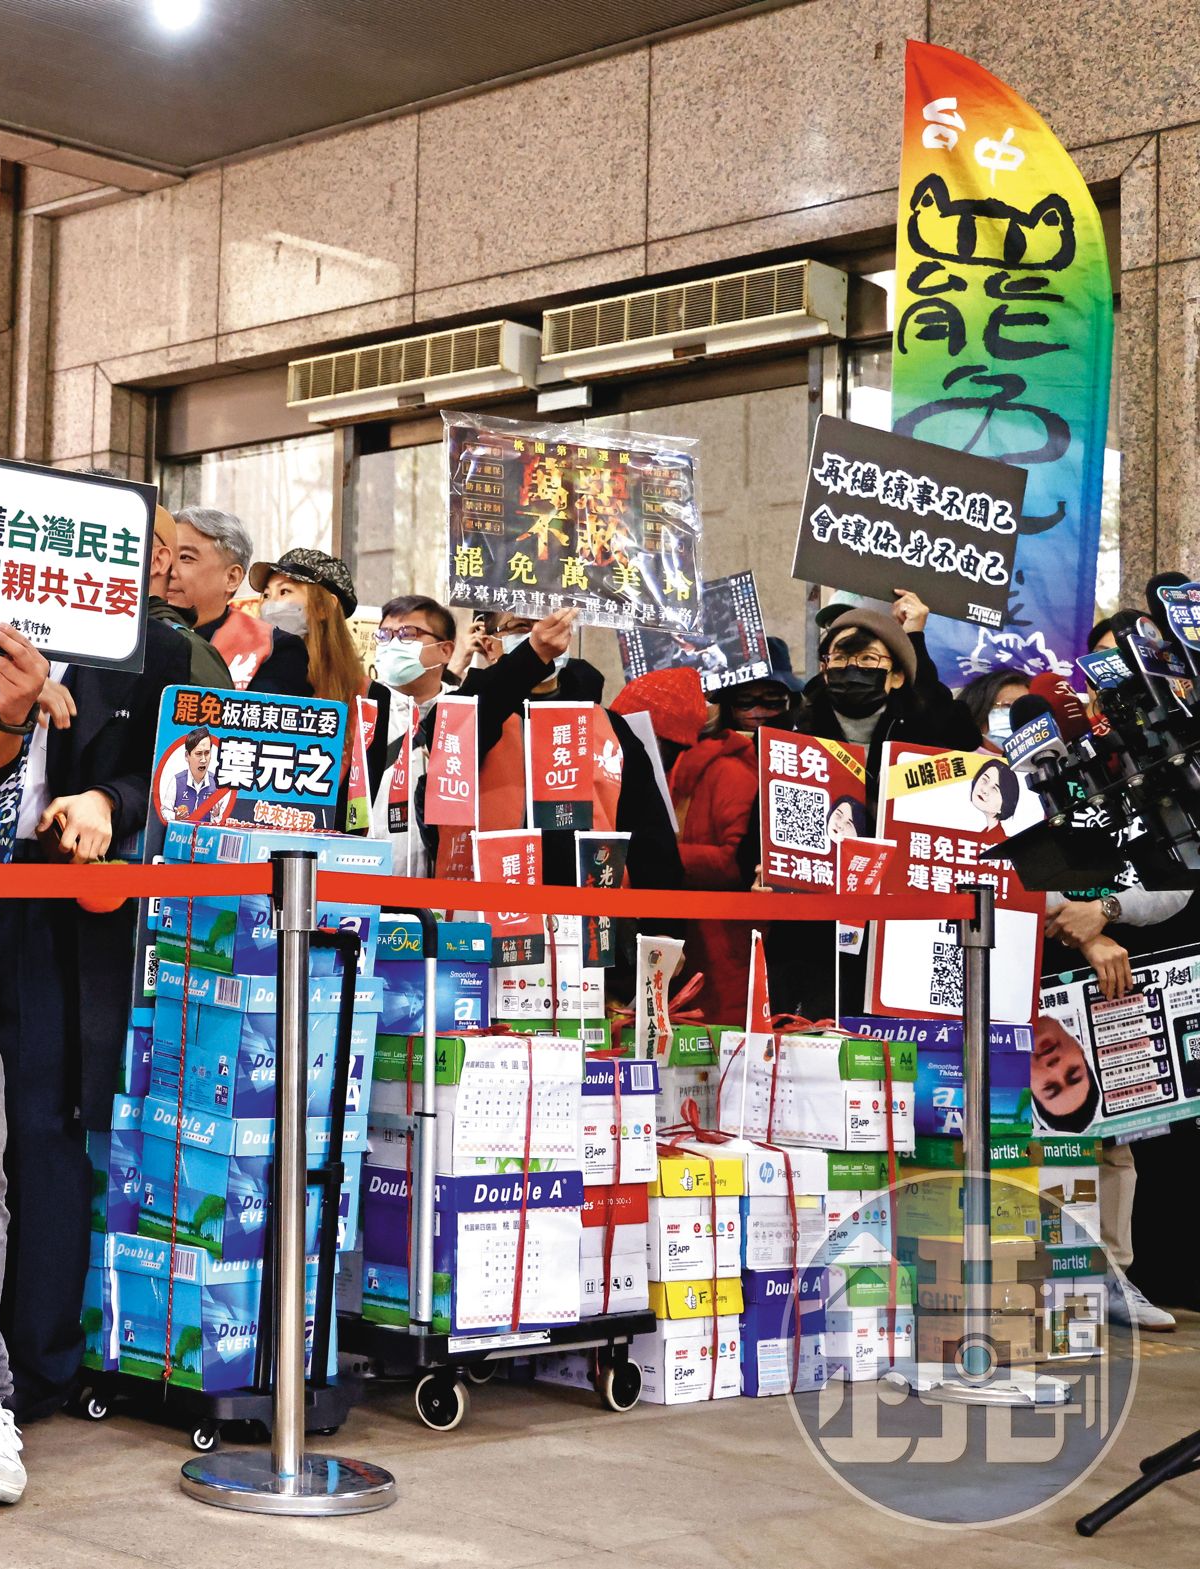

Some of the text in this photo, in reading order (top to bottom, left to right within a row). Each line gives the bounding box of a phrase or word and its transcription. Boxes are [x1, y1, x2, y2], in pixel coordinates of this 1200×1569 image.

[513, 439, 630, 466] 桃園第四選區
[812, 452, 1017, 535] 再繼續事不關己
[809, 504, 1009, 587] 會讓你身不由己
[731, 575, 751, 586] 5/17
[174, 691, 337, 736] 罷免板橋東區立委
[1004, 717, 1048, 752] mnews
[1034, 729, 1050, 744] 86
[552, 724, 572, 767] 罷免
[217, 739, 335, 794] 葉元之
[769, 739, 830, 783] 罷免
[545, 768, 579, 786] OUT
[905, 756, 967, 789] 山除薇害
[254, 800, 315, 829] 快來找我
[336, 856, 378, 865] EVERYDAY
[769, 851, 834, 887] 王鴻薇
[450, 970, 477, 979] Smoother
[460, 978, 483, 986] Thicker
[936, 1026, 949, 1042] A
[679, 1037, 696, 1052] BLC
[900, 1052, 912, 1065] A4
[928, 1062, 959, 1070] Smoother
[585, 1070, 613, 1084] ouble
[205, 1123, 216, 1135] A
[859, 1119, 869, 1127] APP
[594, 1147, 606, 1156] APP
[1043, 1143, 1081, 1158] martist
[777, 1168, 801, 1179] Paers
[474, 1180, 562, 1204] Double A
[837, 1231, 848, 1239] APP
[115, 1243, 166, 1262] Double A
[677, 1245, 690, 1254] APP
[1052, 1254, 1088, 1271] martist
[812, 1276, 822, 1292] A
[863, 1347, 873, 1355] APP
[683, 1368, 695, 1378] APP
